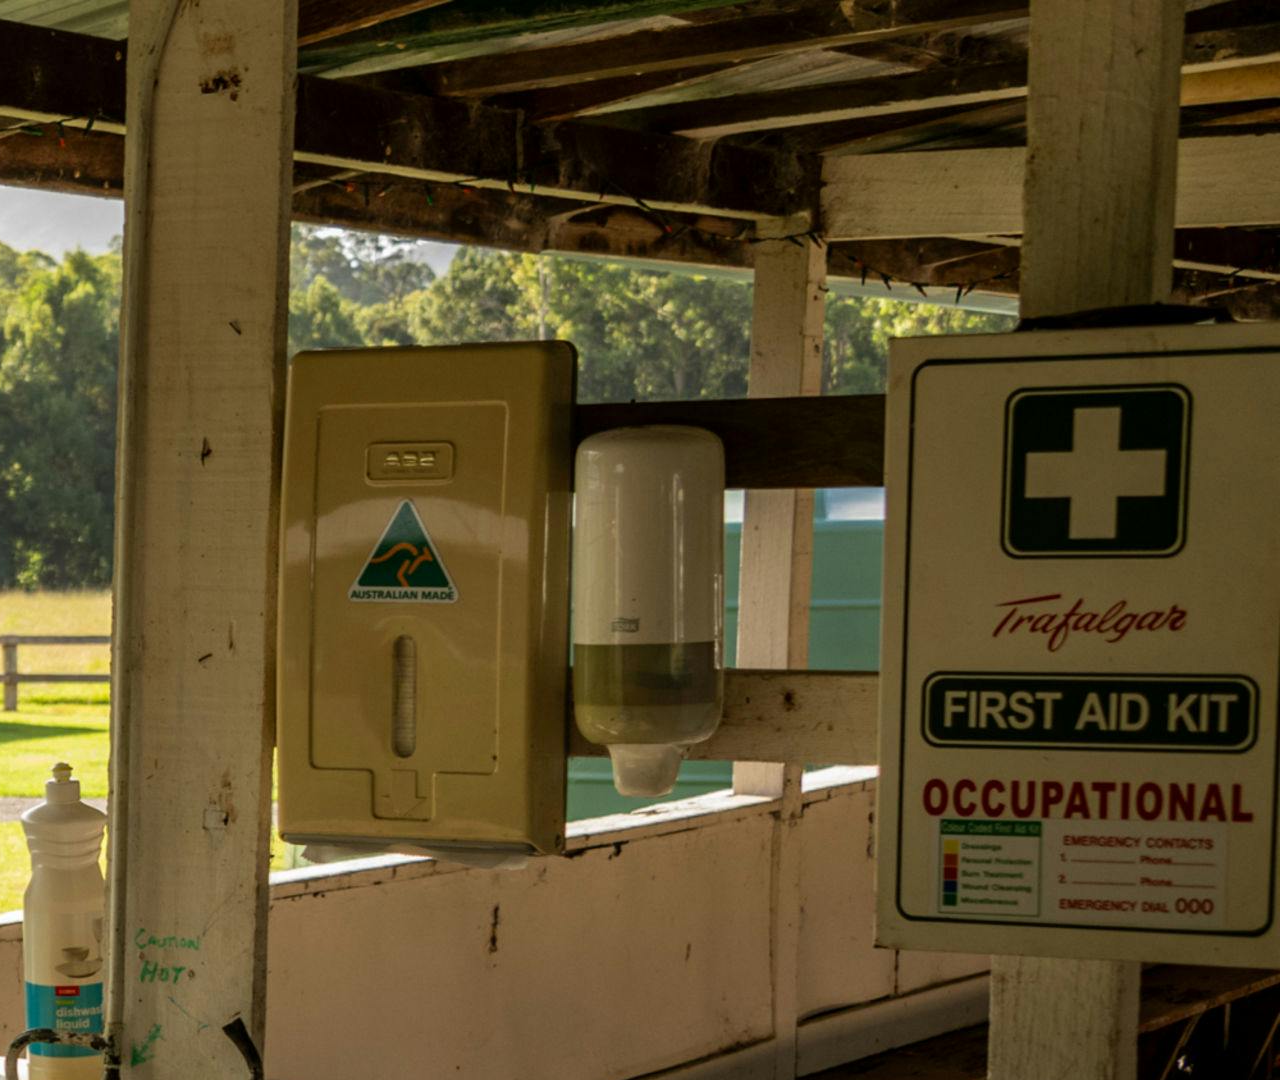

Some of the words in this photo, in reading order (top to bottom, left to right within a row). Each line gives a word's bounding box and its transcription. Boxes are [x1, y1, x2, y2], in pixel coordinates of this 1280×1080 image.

[351, 590, 419, 600] AUSTRALIAN
[421, 591, 455, 601] MADE
[992, 594, 1187, 652] Trafalgar
[942, 690, 1063, 730] FIRST
[1075, 692, 1151, 732] AID
[1167, 693, 1239, 733] KIT
[922, 778, 1254, 823] OCCUPATIONAL
[1063, 835, 1140, 848] EMERGENCY
[1146, 837, 1214, 850] CONTACTS
[1059, 898, 1137, 912] EMERGENCY
[1142, 901, 1170, 913] DIAL
[1175, 897, 1214, 915] 000
[139, 960, 187, 984] HOT
